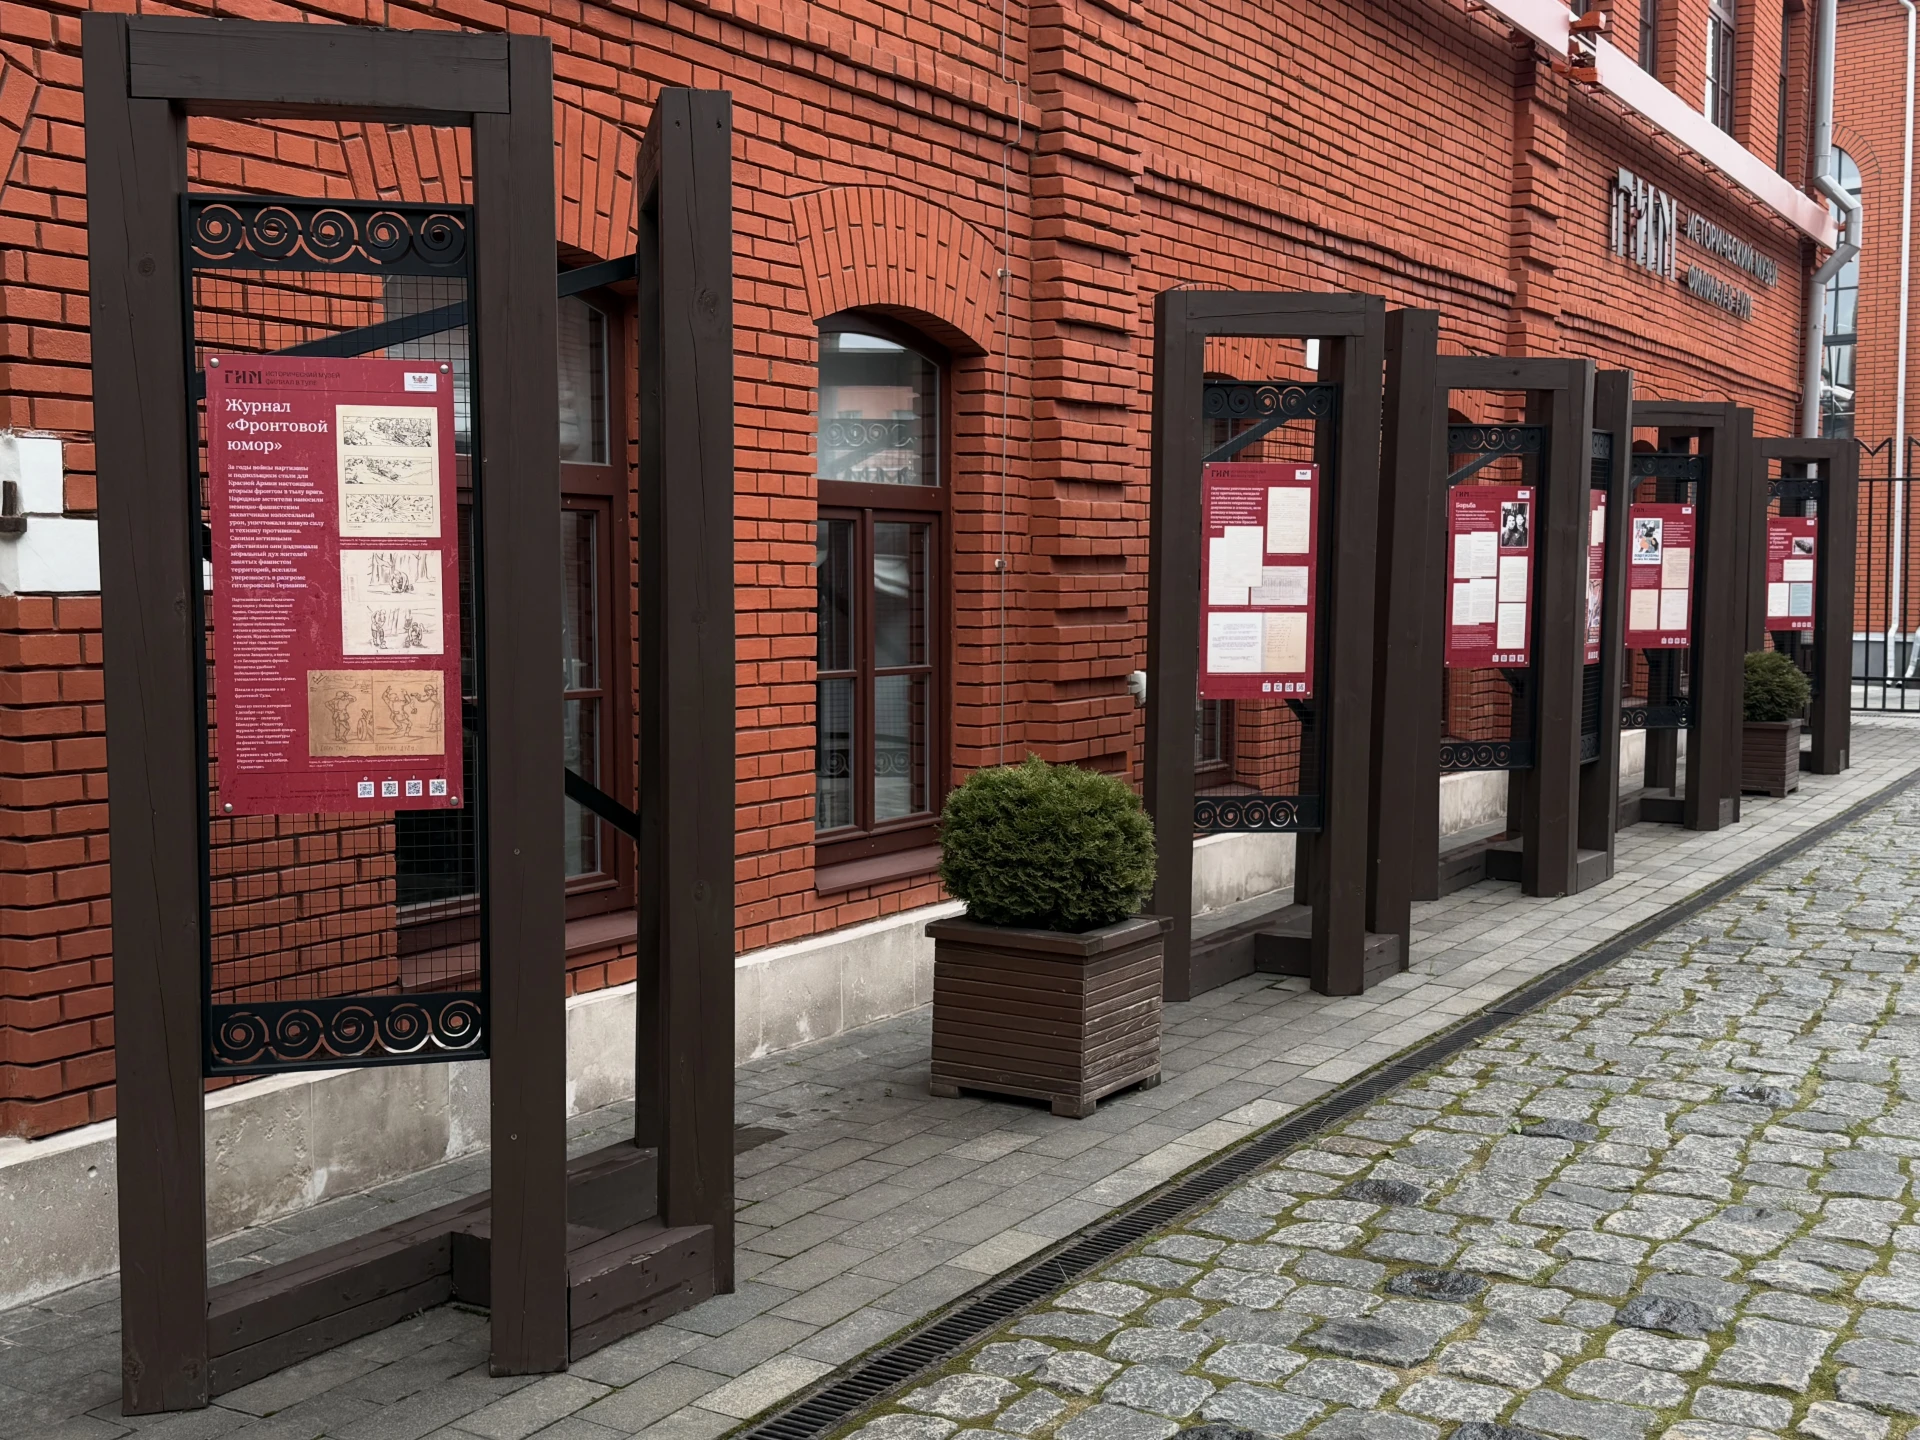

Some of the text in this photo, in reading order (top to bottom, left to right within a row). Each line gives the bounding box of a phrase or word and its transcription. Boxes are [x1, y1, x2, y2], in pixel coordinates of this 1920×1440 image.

[1687, 210, 1778, 289] ИСТОРИЧЕСКИЙ МУЗЕЙ
[1688, 264, 1726, 309] ФИЛИАЛ
[225, 370, 262, 384] ГИМ
[226, 399, 291, 415] Журнал
[227, 418, 328, 434] «Фронтовой
[227, 441, 282, 454] юмор»
